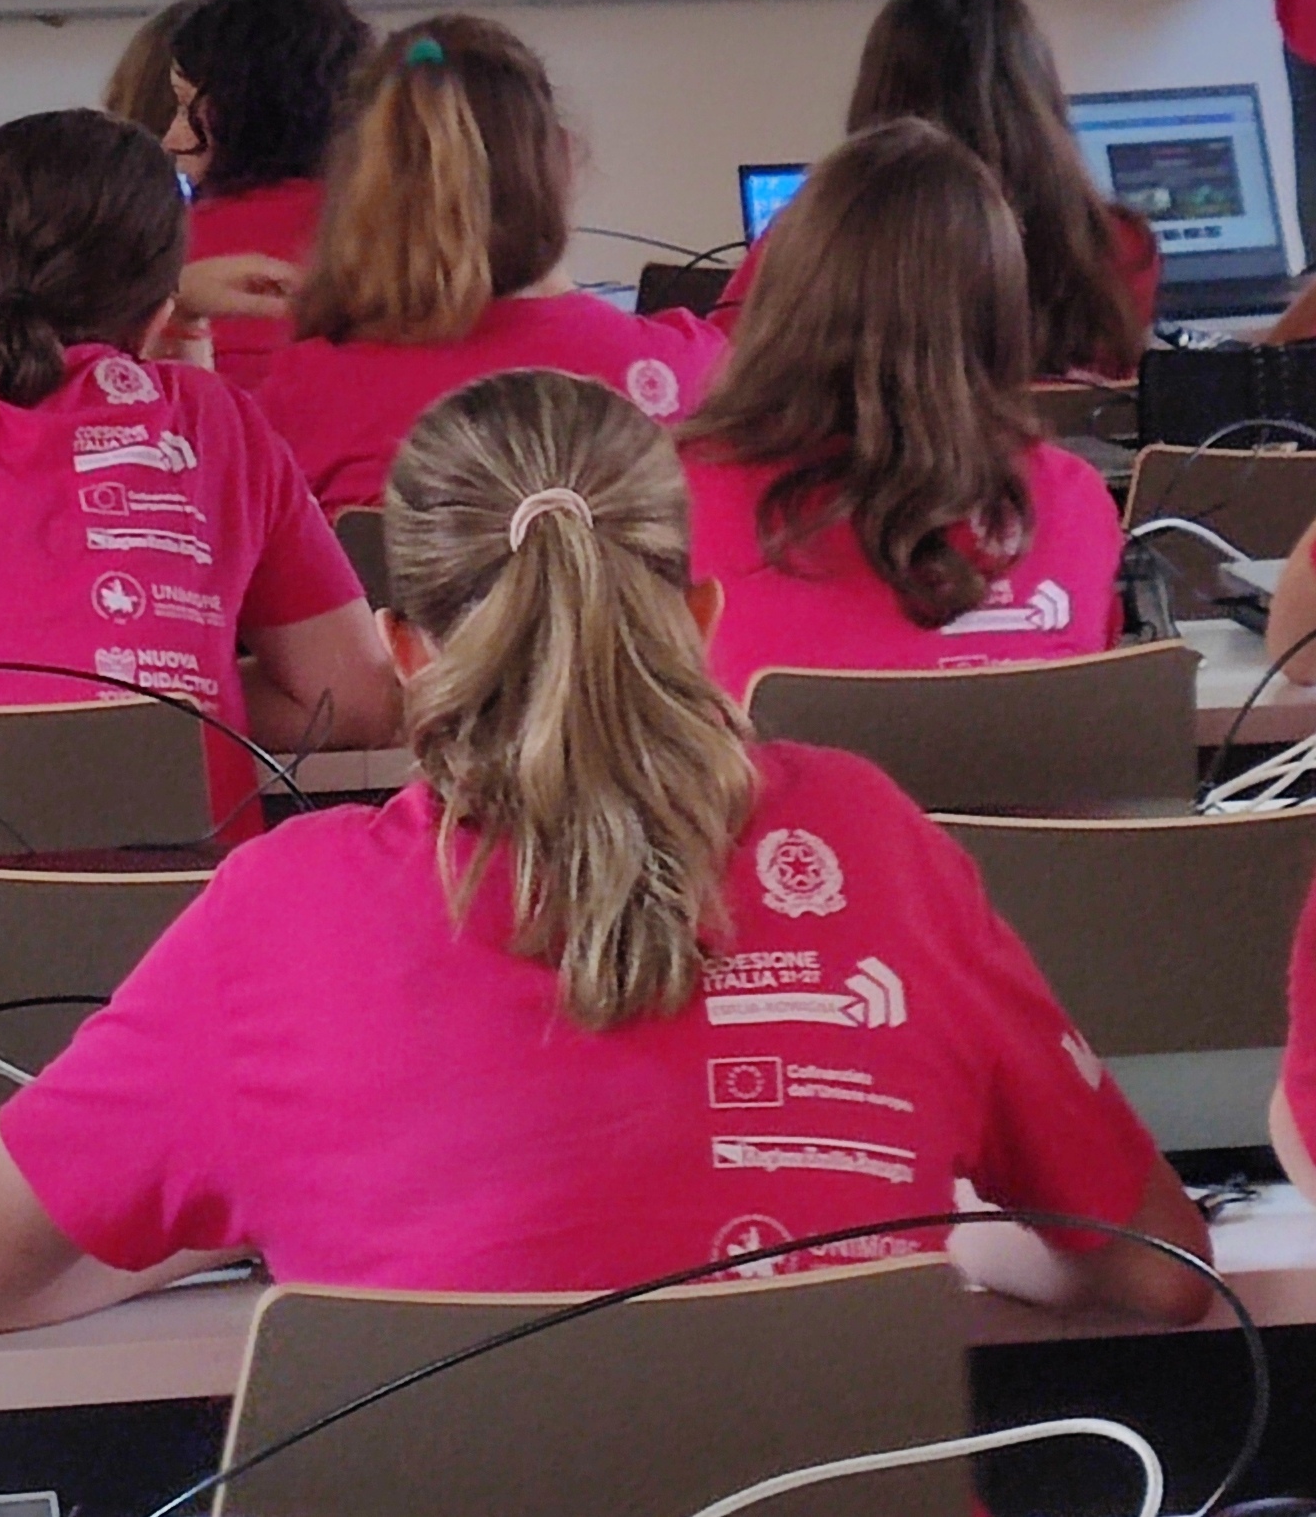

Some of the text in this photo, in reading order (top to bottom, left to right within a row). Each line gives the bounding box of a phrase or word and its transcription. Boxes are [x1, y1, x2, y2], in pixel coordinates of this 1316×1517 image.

[137, 648, 200, 672] NUOVA
[701, 950, 821, 975] COESIONE
[703, 970, 779, 992] ITALIA
